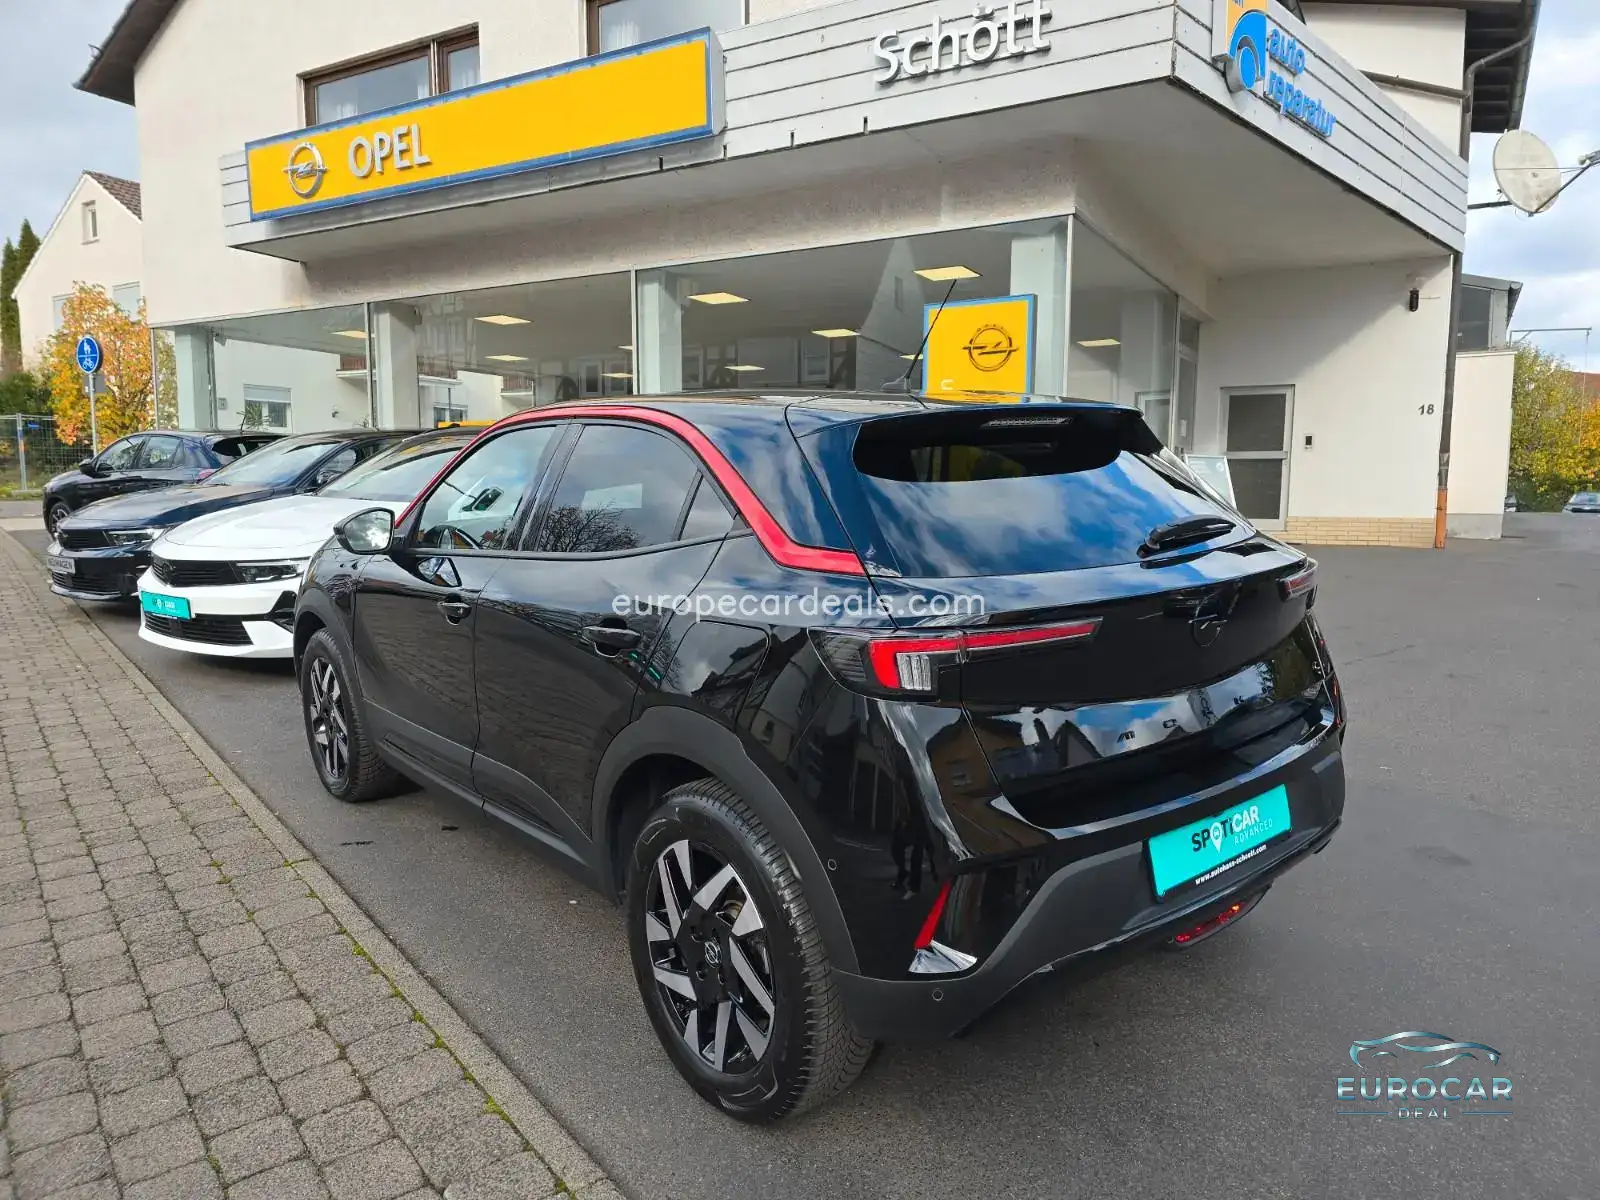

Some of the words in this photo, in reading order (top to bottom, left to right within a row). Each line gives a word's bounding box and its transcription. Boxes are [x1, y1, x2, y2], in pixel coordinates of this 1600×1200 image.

[873, 0, 1052, 85] Schött
[1268, 28, 1305, 75] auto
[1269, 69, 1336, 137] reparatur
[348, 123, 432, 178] OPEL
[1418, 403, 1435, 416] 18
[1234, 818, 1273, 846] ADVANCED
